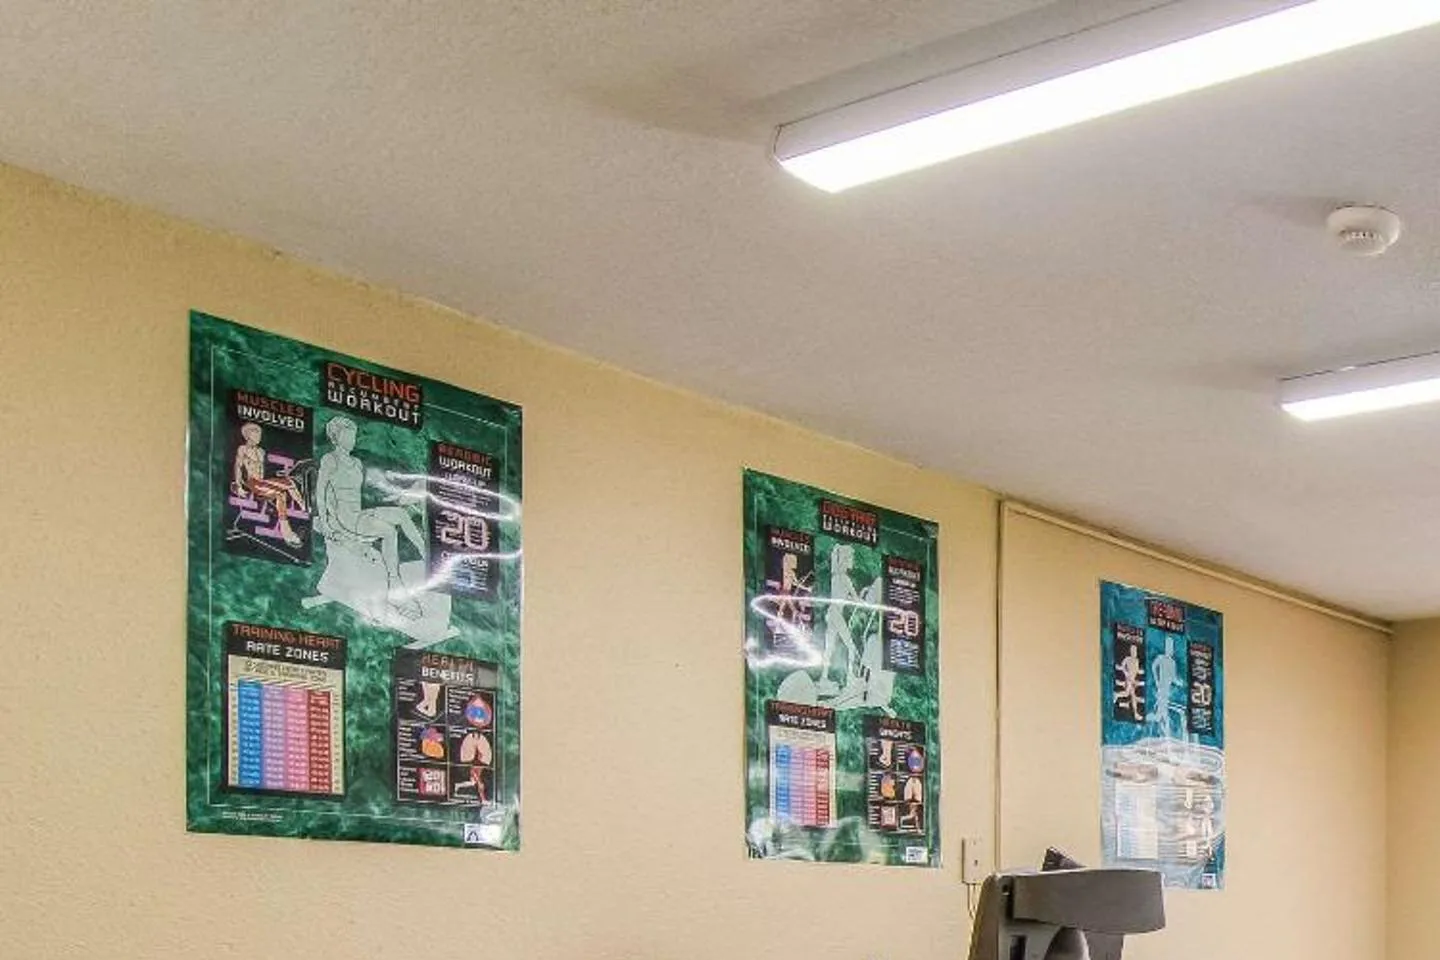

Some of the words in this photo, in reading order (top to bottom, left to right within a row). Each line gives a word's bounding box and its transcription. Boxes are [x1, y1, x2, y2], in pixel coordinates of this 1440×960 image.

[327, 362, 420, 403] CYCLING
[236, 390, 305, 417] MUSCLES
[327, 389, 421, 424] WORKOUT
[237, 404, 305, 430] INVOLVED
[439, 455, 492, 478] WORKOUT
[822, 514, 877, 543] WORKOUT
[231, 623, 295, 644] TRAINING
[246, 640, 281, 656] RATE
[285, 646, 330, 663] ZONES
